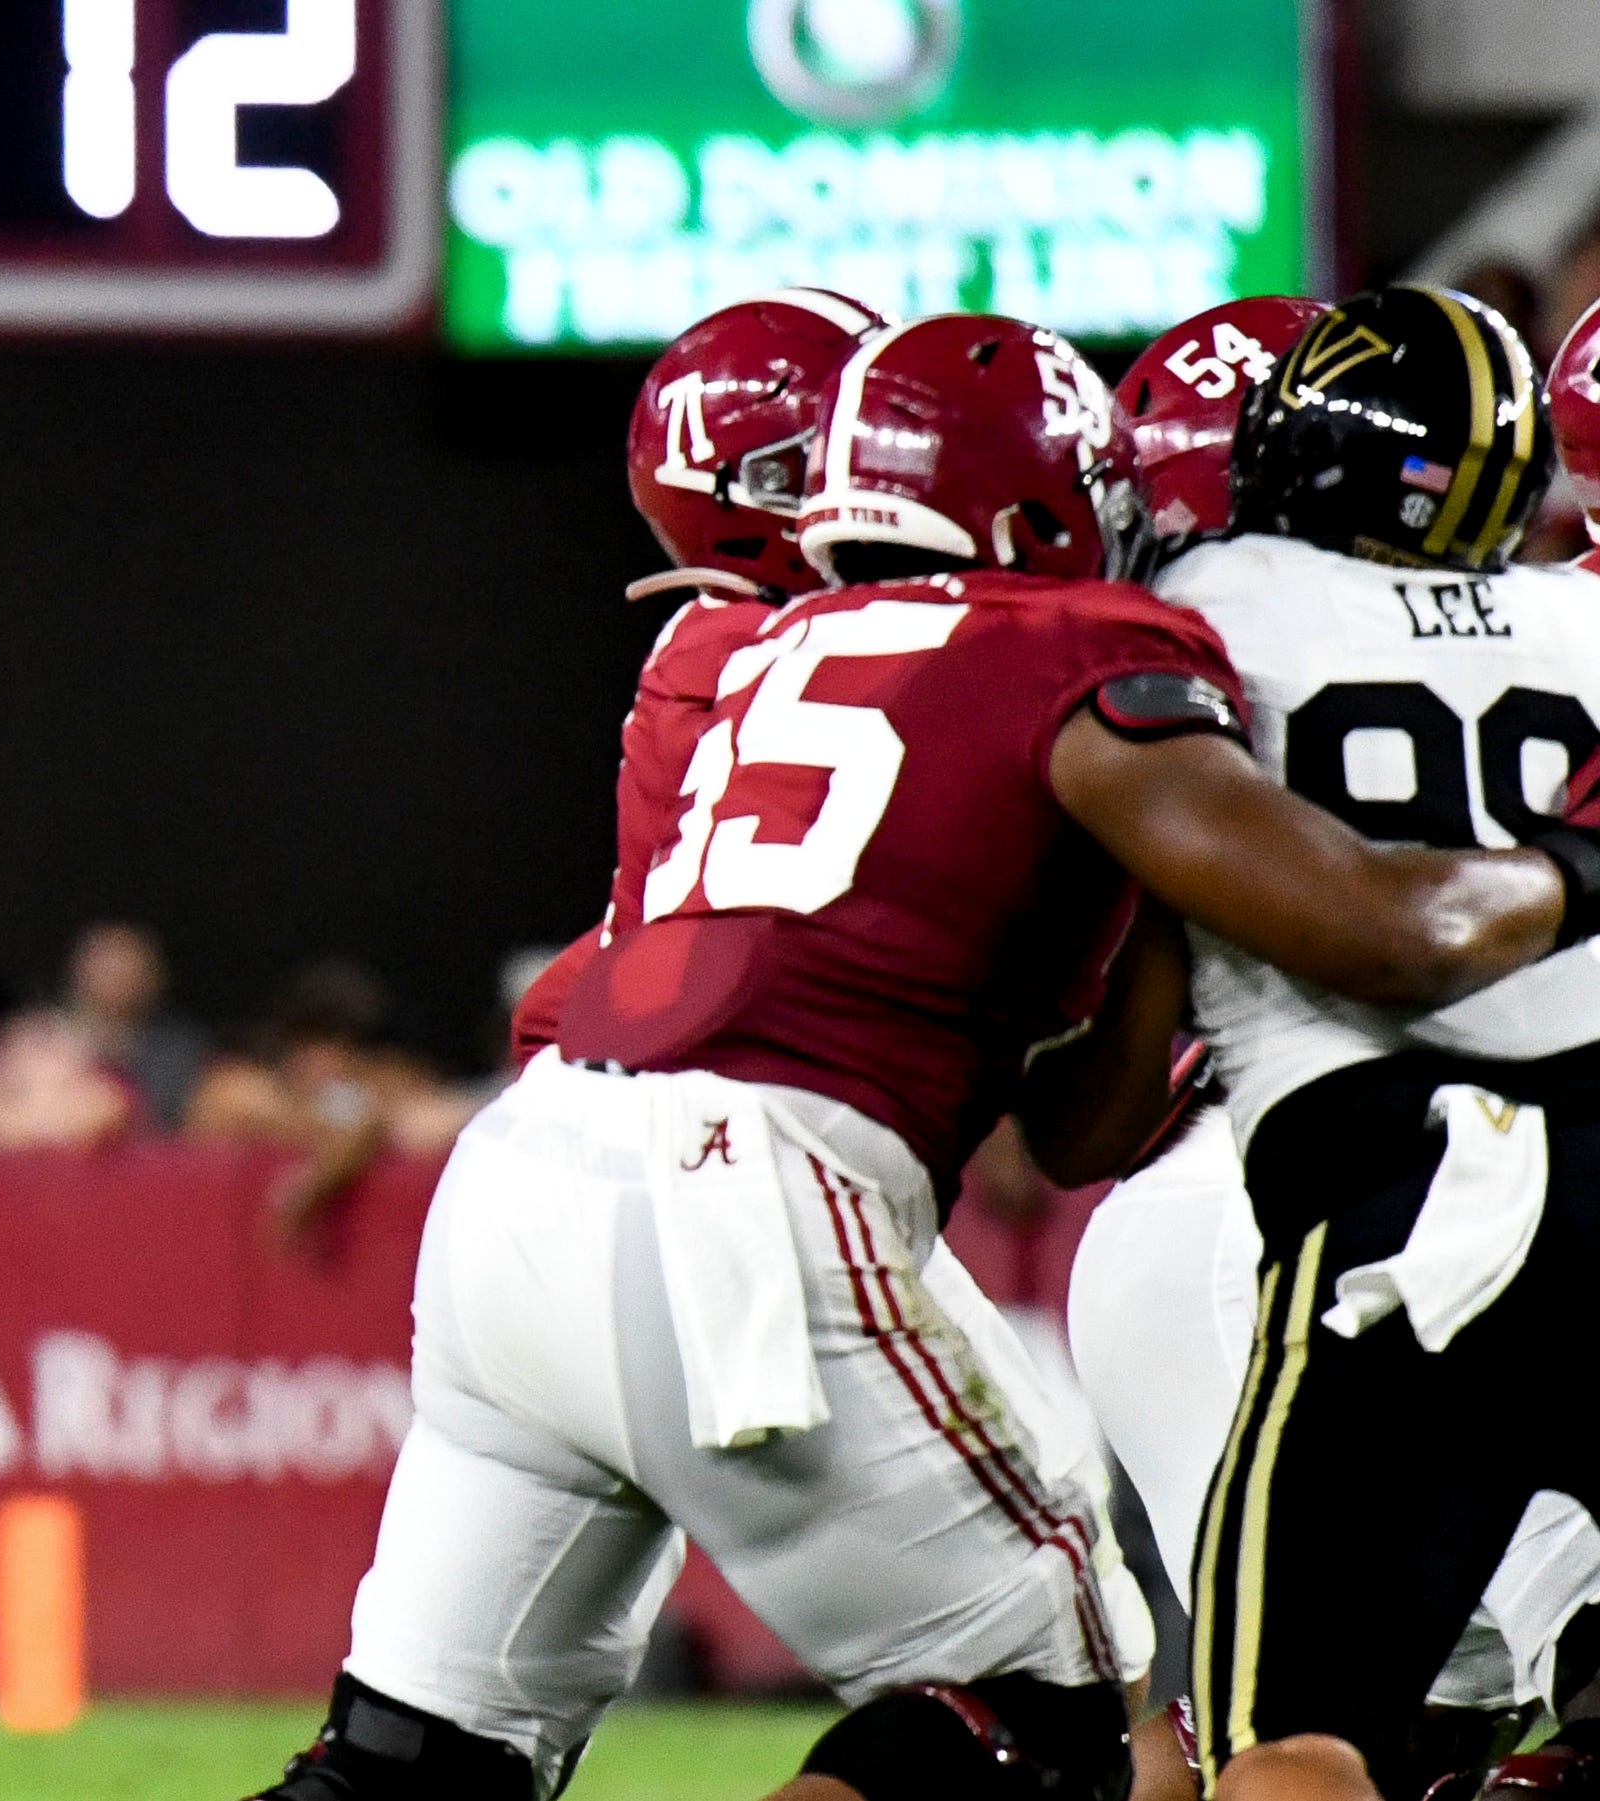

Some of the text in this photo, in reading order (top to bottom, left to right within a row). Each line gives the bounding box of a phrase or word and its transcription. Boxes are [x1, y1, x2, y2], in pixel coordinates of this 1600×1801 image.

[62, 0, 357, 238] 12
[448, 130, 1268, 246] OLD DOMINION
[1163, 322, 1276, 400] 54
[1393, 577, 1513, 638] LEE
[679, 1115, 740, 1171] A
